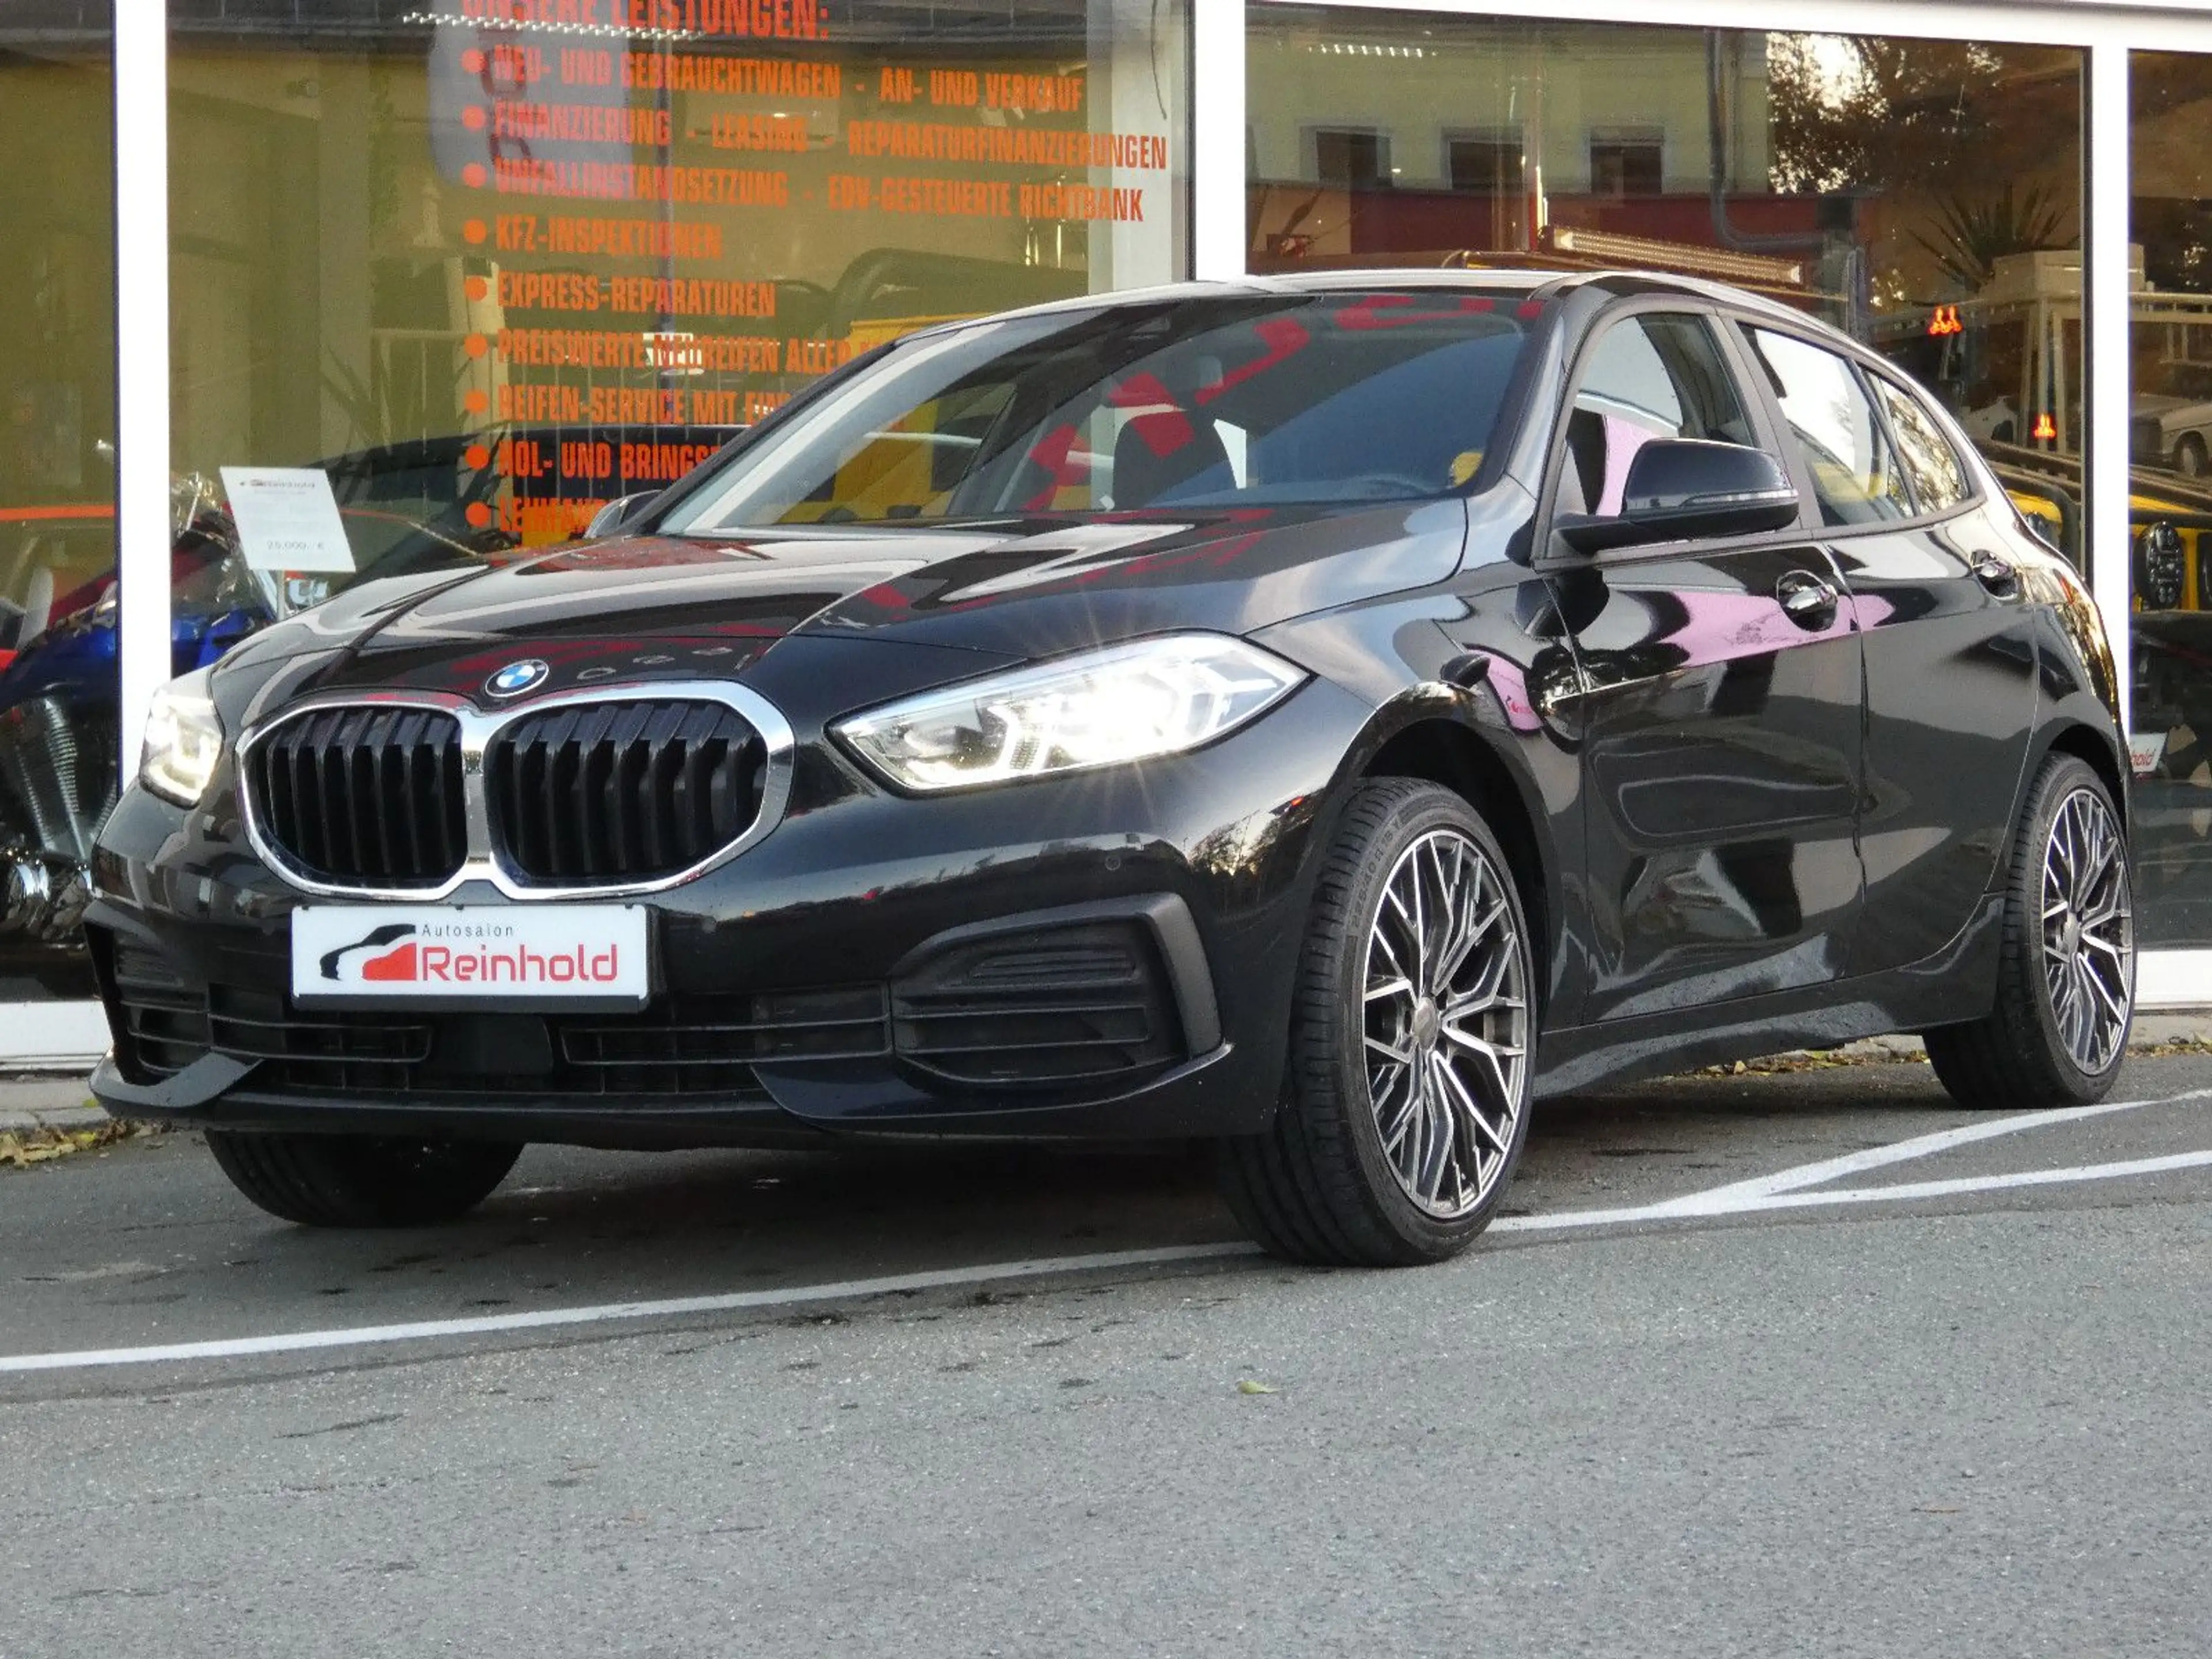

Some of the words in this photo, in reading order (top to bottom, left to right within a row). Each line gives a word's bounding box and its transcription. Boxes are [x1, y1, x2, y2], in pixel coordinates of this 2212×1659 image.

[494, 45, 549, 83] NEU-
[563, 52, 610, 84] UND
[622, 53, 841, 98] GEBRAUCHTWAGEN
[880, 67, 923, 103] AN-
[930, 70, 978, 107] UND
[986, 74, 1082, 111] VERKAUF
[494, 101, 671, 145] FINANZIERUNG
[712, 114, 808, 152] LEASING
[849, 120, 1166, 169] REPARATURFINANZIERUNGEN
[495, 154, 788, 207] UNFALLINSTANDSETZUNG
[830, 176, 1010, 216] EDV-GESTEUERTE
[1019, 184, 1143, 221] RICHTBANK
[497, 215, 721, 258] KFZ-INSPEKTIONEN
[498, 271, 775, 316] EXPRESS-REPARATUREN
[498, 329, 644, 368] PREISWERTE
[654, 334, 778, 372] NEUREIFEN
[499, 385, 684, 423] REIFEN-SERVICE
[694, 392, 736, 423] MIT
[498, 441, 554, 478] HOL-
[561, 442, 612, 478] UND
[620, 443, 719, 479] BRING
[421, 924, 514, 937] Autosalon
[422, 943, 618, 982] Reinhold
